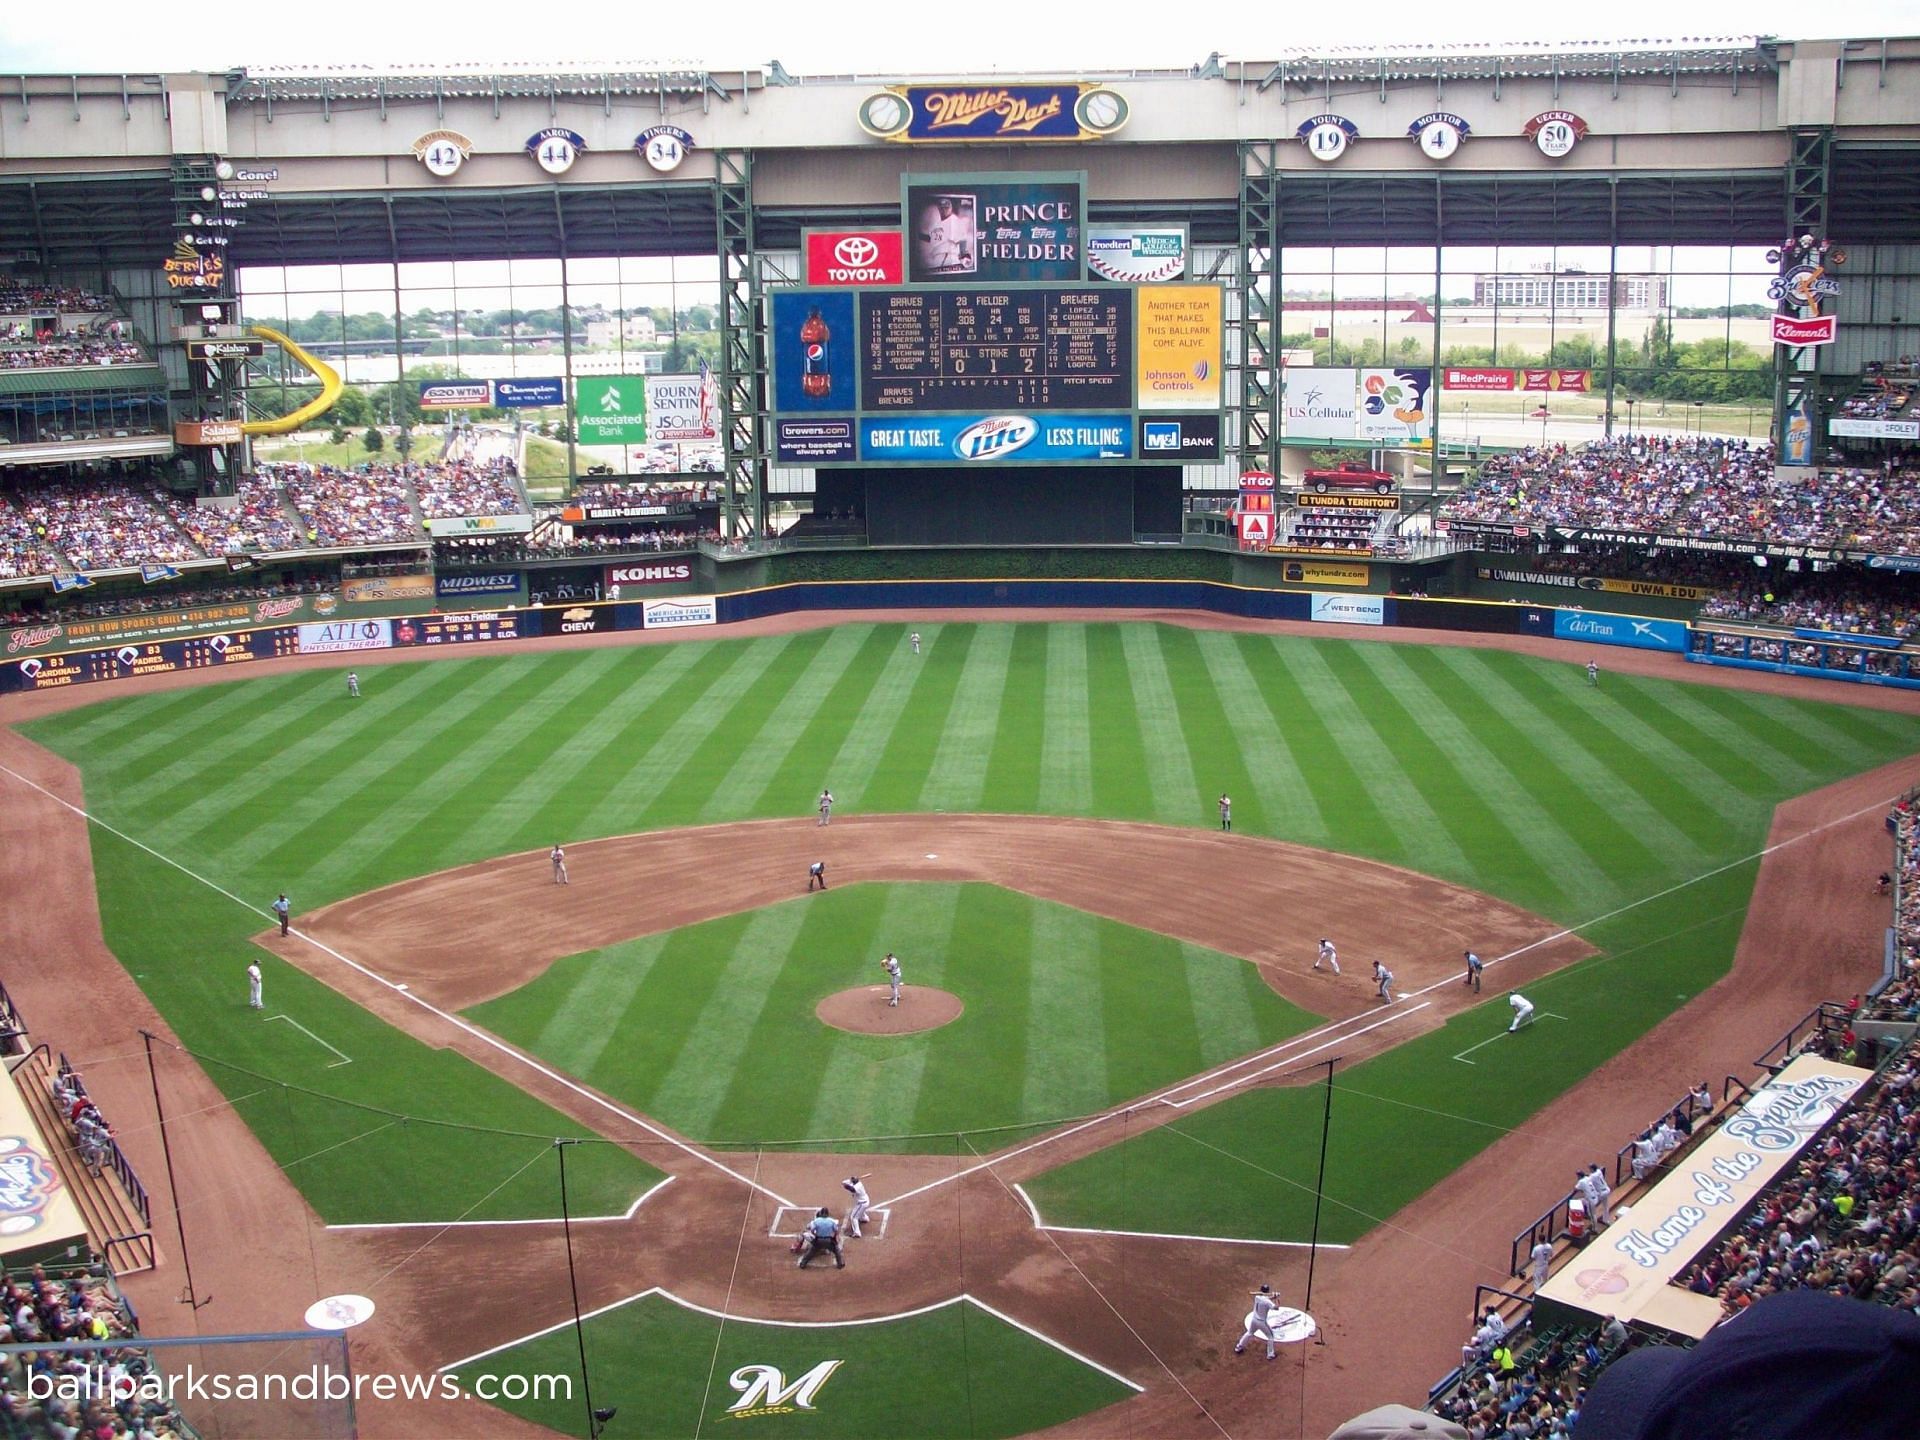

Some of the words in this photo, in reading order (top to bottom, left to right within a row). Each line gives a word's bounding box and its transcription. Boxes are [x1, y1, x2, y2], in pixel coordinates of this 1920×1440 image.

[926, 92, 1006, 131] Miller
[996, 95, 1062, 134] Park
[1535, 113, 1573, 123] UECKER
[1311, 115, 1344, 126] YOUNT
[1417, 115, 1460, 127] MOLITOR
[540, 129, 571, 139] AARON
[643, 127, 684, 139] FINGERS
[1544, 126, 1566, 142] 50
[1314, 130, 1340, 150] 19
[1431, 129, 1445, 149] 4
[430, 147, 455, 165] 42
[542, 145, 568, 161] 44
[652, 143, 677, 160] 34
[237, 170, 278, 180] Gone!
[218, 192, 237, 200] Get
[239, 192, 269, 200] Outta
[985, 203, 1072, 222] PRINCE
[206, 218, 223, 226] Get
[225, 218, 238, 227] Up
[196, 237, 212, 245] Get
[215, 237, 228, 246] Up
[1091, 240, 1131, 250] Froedtert
[982, 244, 1074, 260] FIELDER
[828, 268, 886, 281] TOYOTA
[890, 297, 923, 307] BRAVES
[956, 297, 967, 305] 28
[976, 296, 1009, 305] FIELDER
[1061, 295, 1099, 304] BREWERS
[1148, 301, 1184, 310] ANOTHER
[1189, 302, 1209, 310] TEAM
[990, 316, 1002, 325] 24
[1177, 314, 1204, 322] MAKES
[1169, 327, 1210, 335] BALLPARK
[216, 344, 249, 353] Kalahari
[1153, 339, 1175, 347] COME
[950, 349, 970, 358] BALL
[979, 349, 1009, 358] STRIKE
[1020, 348, 1037, 357] OUT
[956, 359, 964, 373] 0
[991, 359, 997, 373] 1
[1025, 358, 1033, 372] 2
[1145, 370, 1186, 381] Johnson
[1461, 374, 1507, 383] RedPrairie
[499, 384, 557, 396] Champion
[1152, 381, 1193, 390] Controls
[428, 388, 454, 397] 620
[457, 387, 485, 396] WTMJ
[884, 388, 913, 396] BRAVES
[1309, 406, 1354, 418] Cellular
[581, 414, 642, 425] Associated
[981, 418, 1012, 432] Miller
[599, 426, 623, 436] Bank
[785, 426, 847, 436] brewers.com
[1047, 428, 1075, 444] LESS
[871, 430, 907, 447] GREAT
[910, 430, 945, 446] TASTE.
[970, 427, 1026, 457] Lite
[1182, 437, 1213, 446] BANK
[1239, 477, 1273, 486] CITGO
[1310, 496, 1345, 506] TUNDRA
[1347, 497, 1395, 508] TERRITORY
[591, 506, 667, 518] HARLEY-DAVIDSON
[465, 518, 496, 528] WM
[1581, 532, 1648, 544] AMTRAK
[1655, 536, 1688, 547] Amtrak
[1765, 545, 1784, 556] Time
[1784, 546, 1804, 557] Well
[613, 566, 689, 581] KOHL'S
[1305, 569, 1365, 578] whytundra.com
[440, 575, 514, 588] MIDWEST
[1632, 584, 1696, 598] UWM.EDU
[648, 609, 685, 619] AMERICAN
[688, 607, 712, 617] FAMILY
[1331, 603, 1354, 612] WEST
[1356, 605, 1381, 614] BEND
[443, 614, 469, 623] Prince
[471, 613, 498, 621] Fielder
[67, 624, 95, 636] FRONT
[99, 621, 119, 632] ROW
[122, 617, 155, 630] SPORTS
[157, 614, 182, 626] GRILL
[562, 621, 595, 632] CHEVY
[8, 624, 63, 652] Friday's
[320, 623, 355, 642] ATI
[225, 644, 244, 653] METS
[302, 641, 345, 652] PHYSICAL
[348, 638, 392, 650] THERAPY
[133, 655, 163, 666] PADRES
[225, 652, 253, 662] ASTROS
[36, 666, 81, 678] CARDINALS
[133, 662, 175, 675] NATIONALS
[37, 676, 71, 687] PHILLIES
[1723, 1073, 1861, 1153] Brewers
[1712, 1148, 1761, 1185] the
[1693, 1171, 1735, 1208] of
[1616, 1204, 1704, 1268] Home
[724, 1359, 845, 1412] M
